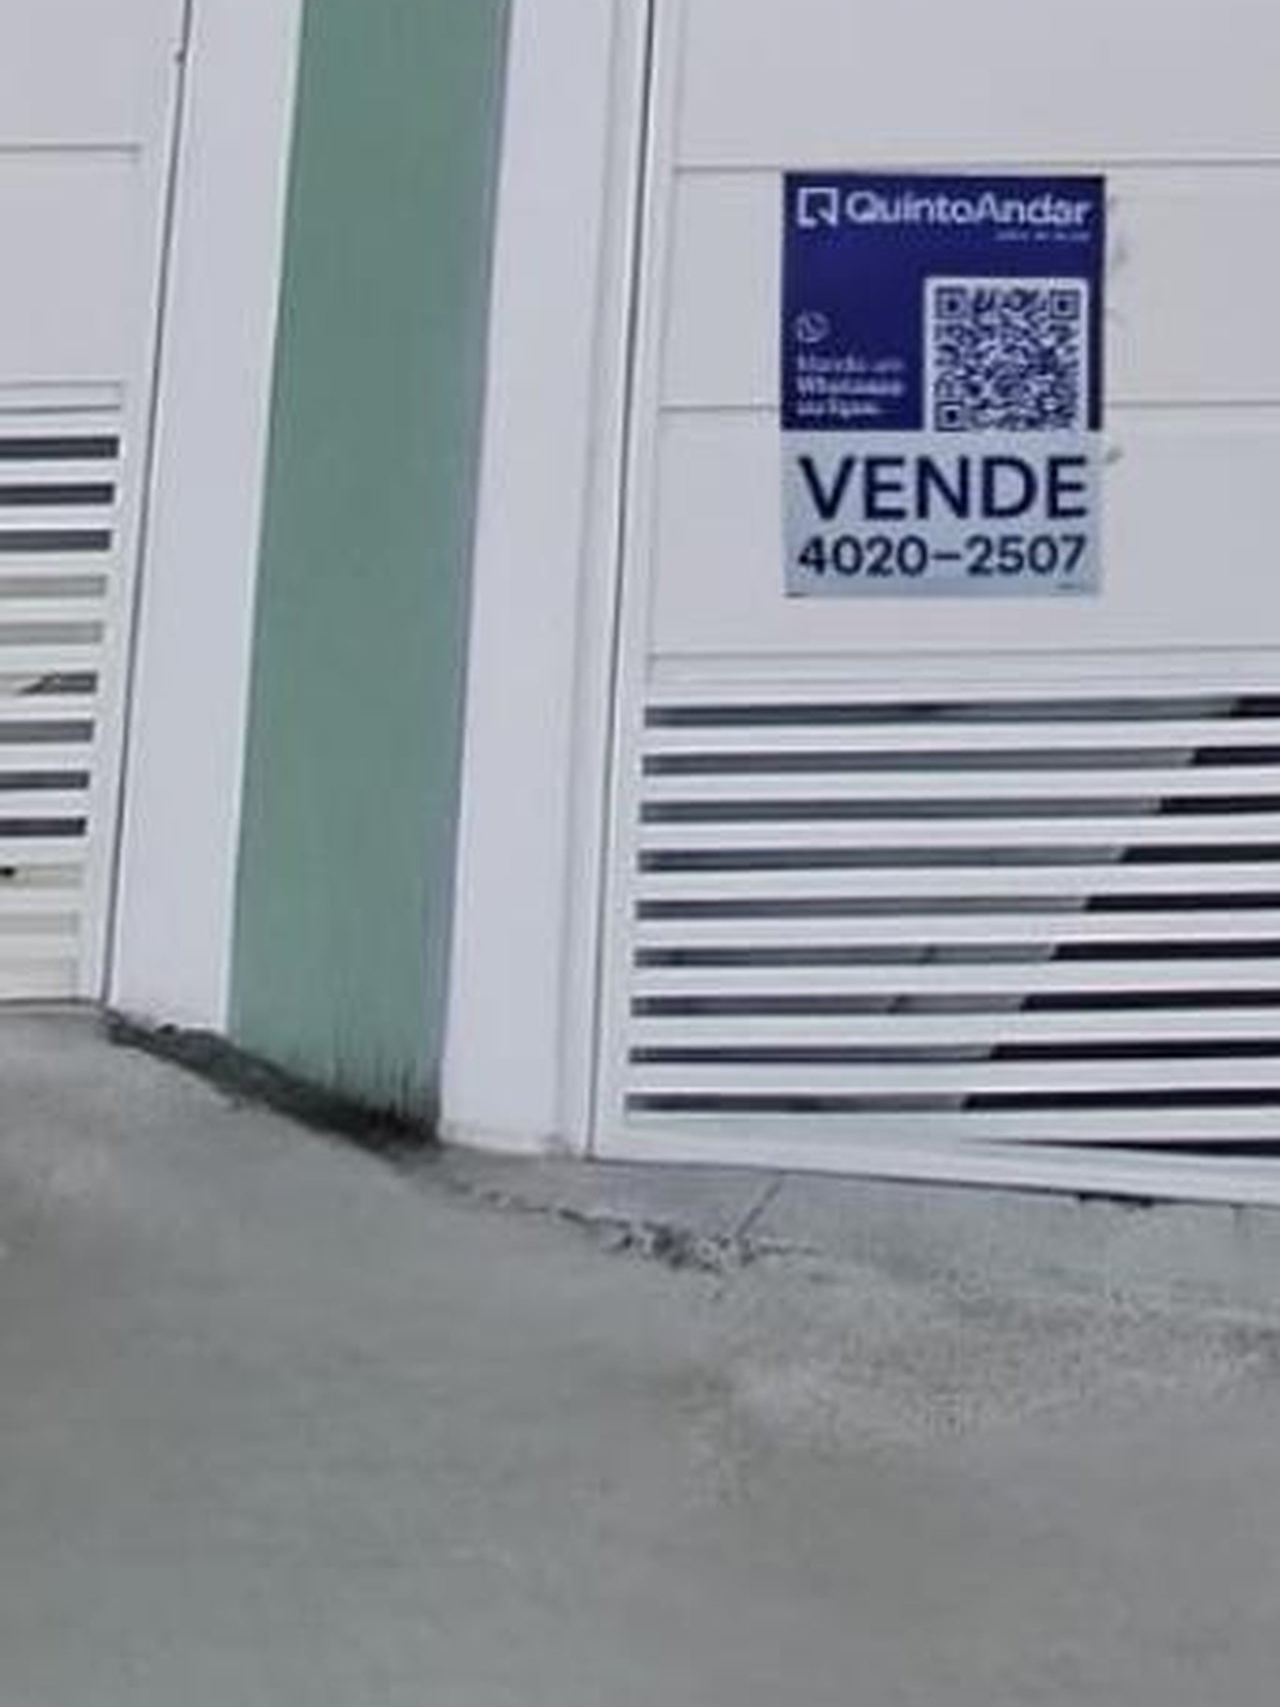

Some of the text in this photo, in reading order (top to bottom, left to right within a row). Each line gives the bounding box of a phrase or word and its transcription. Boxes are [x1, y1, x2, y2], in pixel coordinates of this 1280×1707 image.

[845, 189, 1092, 225] QuintoAndar
[797, 455, 1088, 520] VENDE
[797, 534, 1088, 577] 4020-2507
